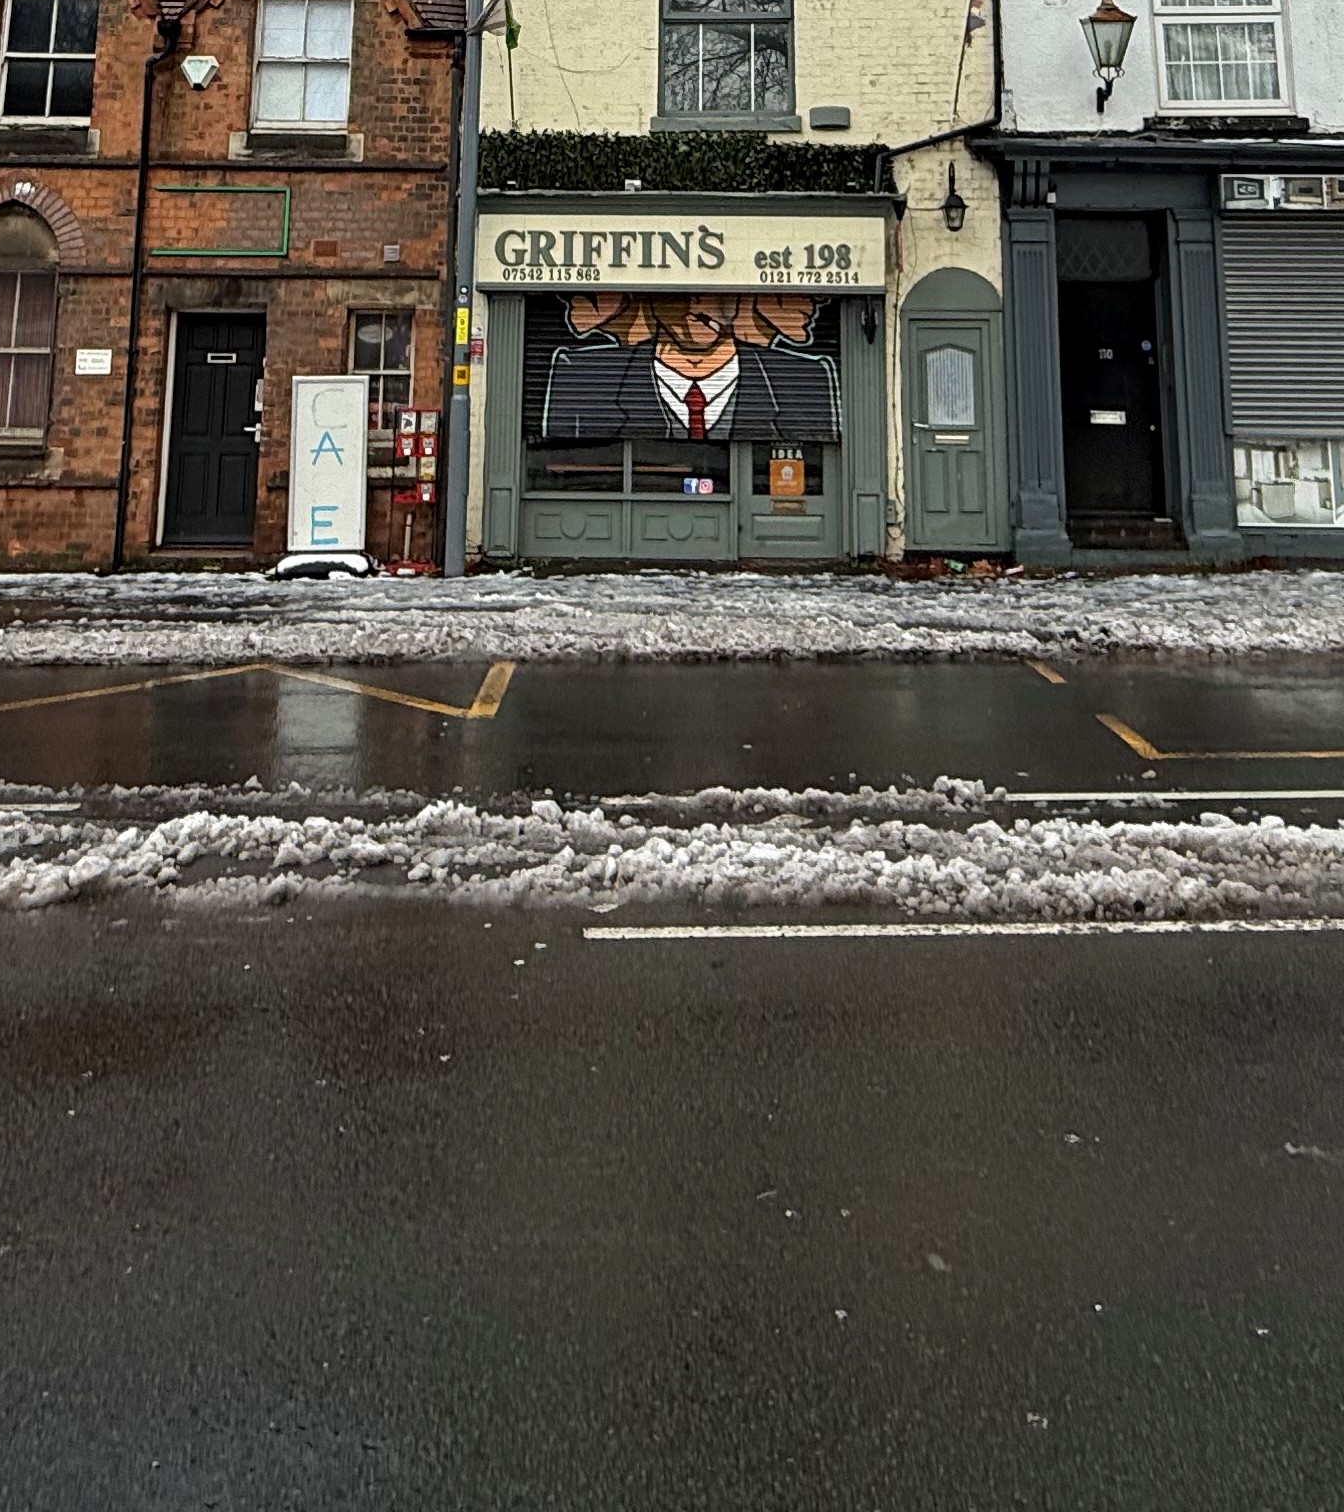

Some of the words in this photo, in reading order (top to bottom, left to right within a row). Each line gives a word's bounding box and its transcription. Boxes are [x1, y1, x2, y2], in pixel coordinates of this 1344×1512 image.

[754, 245, 793, 270] est
[502, 267, 544, 281] 07542
[548, 268, 572, 281] 115
[576, 267, 601, 281] 862
[759, 270, 792, 284] 0121
[797, 271, 822, 283] 772
[826, 271, 860, 284] 2514
